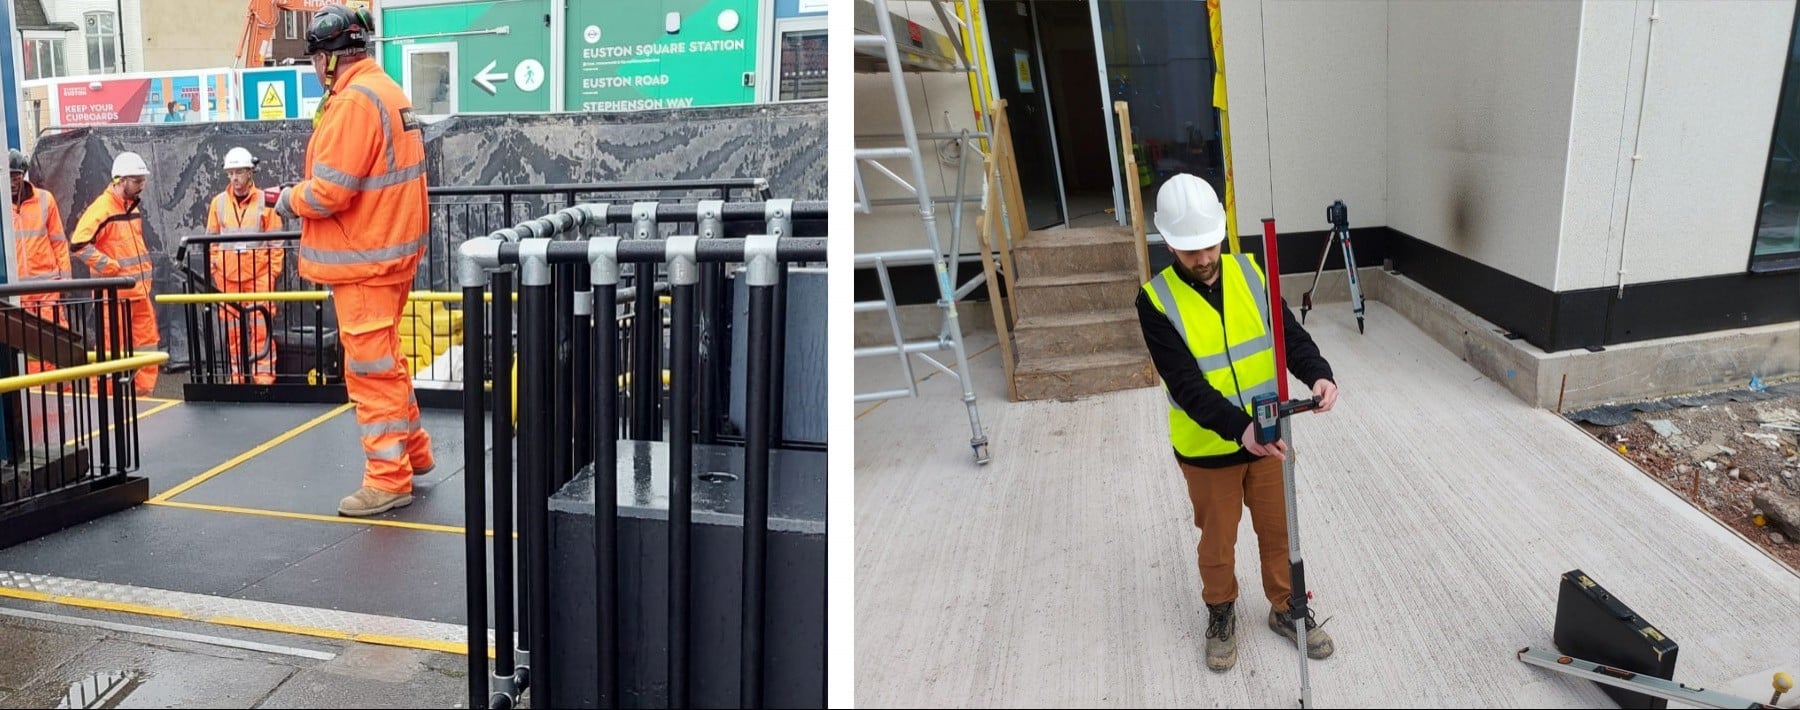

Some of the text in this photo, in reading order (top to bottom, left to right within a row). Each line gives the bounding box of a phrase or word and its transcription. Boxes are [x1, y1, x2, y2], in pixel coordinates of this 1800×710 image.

[583, 39, 744, 59] EUSTON SQUARE STATION
[583, 74, 669, 88] EUSTON ROAD
[583, 98, 694, 111] STEPHENSON WAY
[66, 112, 119, 121] CUPBOARDS
